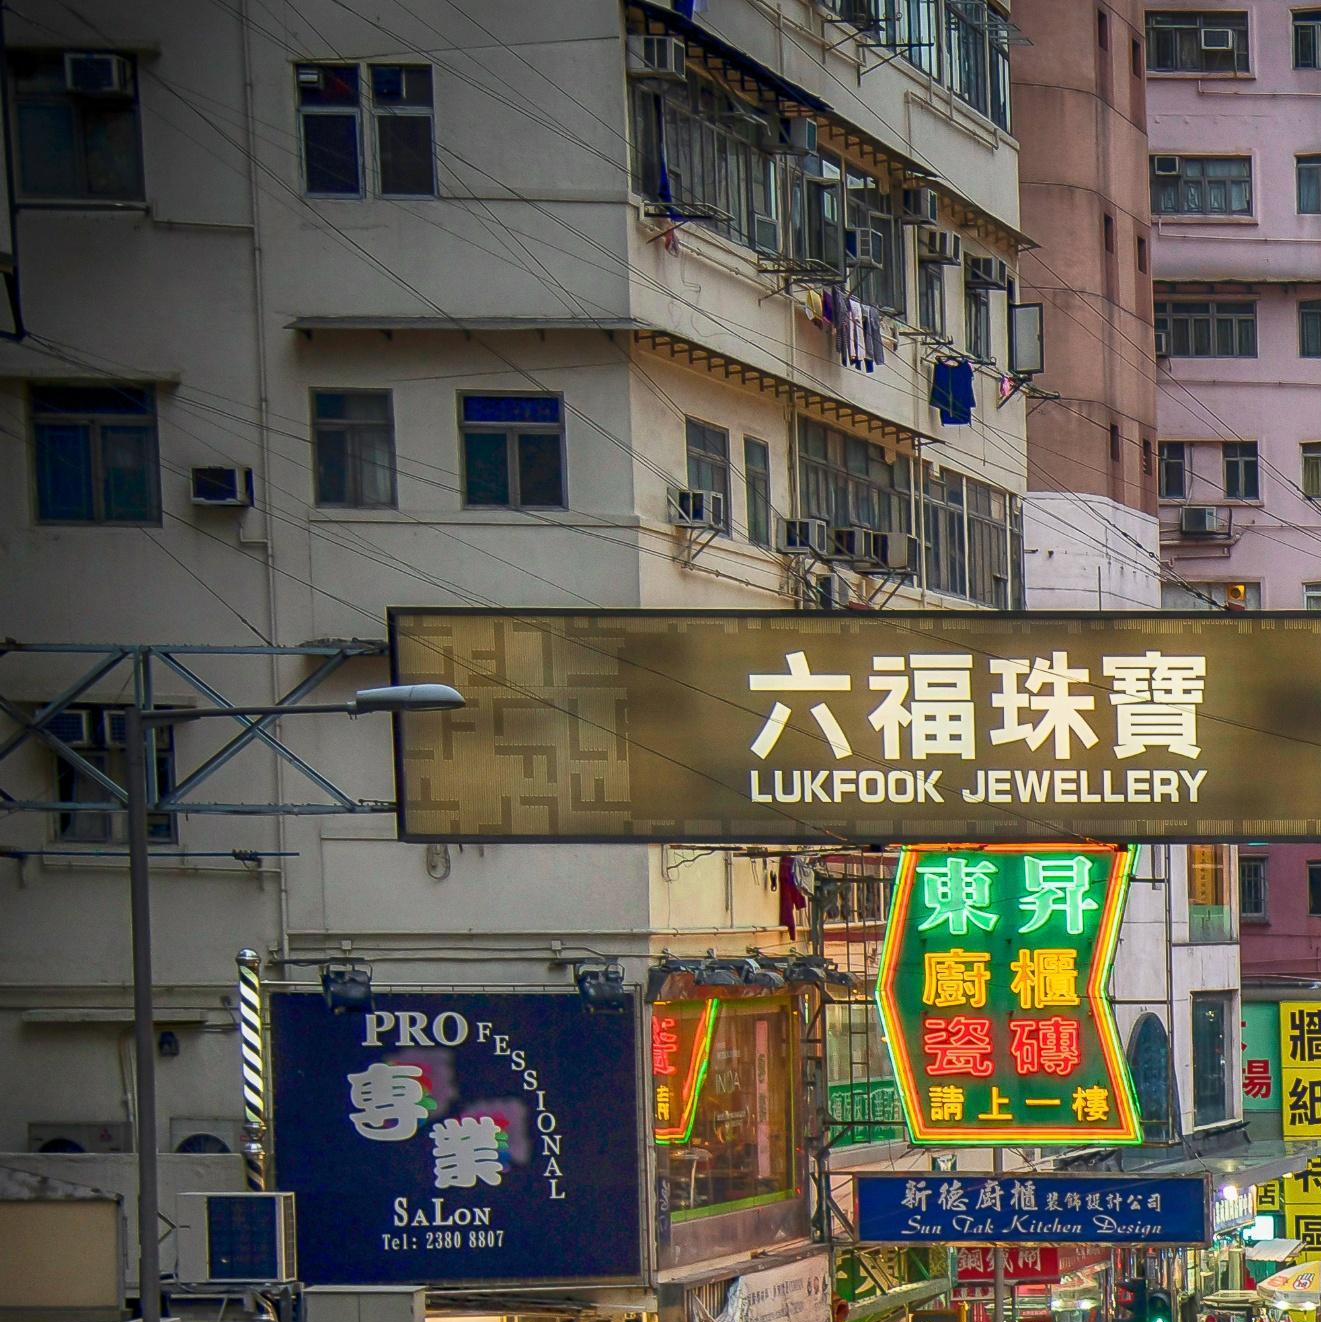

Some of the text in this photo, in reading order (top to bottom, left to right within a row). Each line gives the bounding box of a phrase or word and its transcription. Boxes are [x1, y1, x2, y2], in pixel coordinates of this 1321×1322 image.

[749, 650, 1207, 761] 六福珠寶
[750, 768, 1208, 805] LUKFOOK JEWELLERY
[916, 856, 1099, 935] 東昇
[923, 949, 1081, 1010] 廚櫃
[925, 1016, 1081, 1077] 瓷磚
[347, 1062, 504, 1189] 專業
[928, 1086, 1111, 1122] 請上一樓
[901, 1180, 1163, 1213] 新德廚櫃 裝飾設計公司
[382, 1230, 505, 1250] Tel: 2380 8807
[901, 1214, 1163, 1238] Sun Tak Kitchen Design
